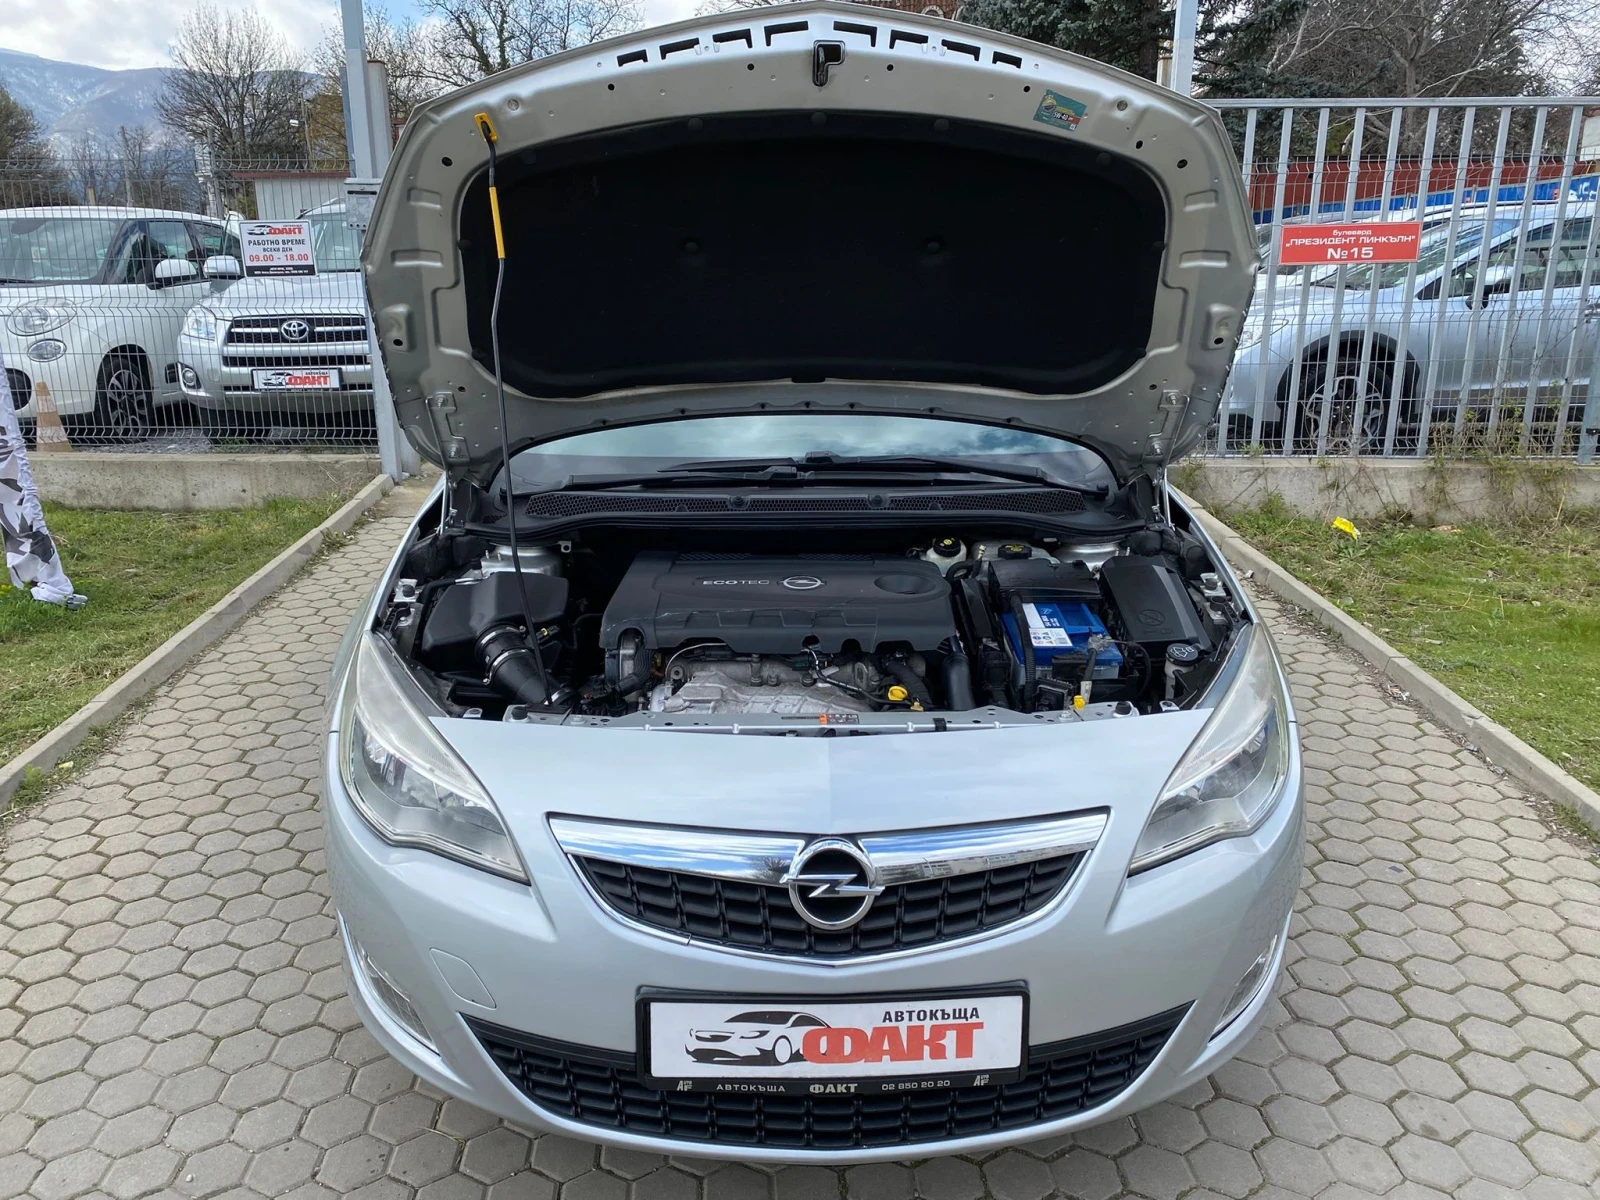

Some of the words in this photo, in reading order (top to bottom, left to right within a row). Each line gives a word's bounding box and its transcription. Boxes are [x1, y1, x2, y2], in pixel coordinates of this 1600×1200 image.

[269, 227, 303, 235] ФАКТ
[249, 254, 274, 262] 09.00
[284, 253, 309, 261] 18.00
[288, 376, 330, 385] ФАКТ
[882, 1007, 980, 1023] АВТОКЪЩА
[802, 1022, 984, 1063] ФАКТ
[809, 1083, 858, 1093] ФАКТ
[881, 1083, 895, 1091] 02
[898, 1082, 918, 1090] 850
